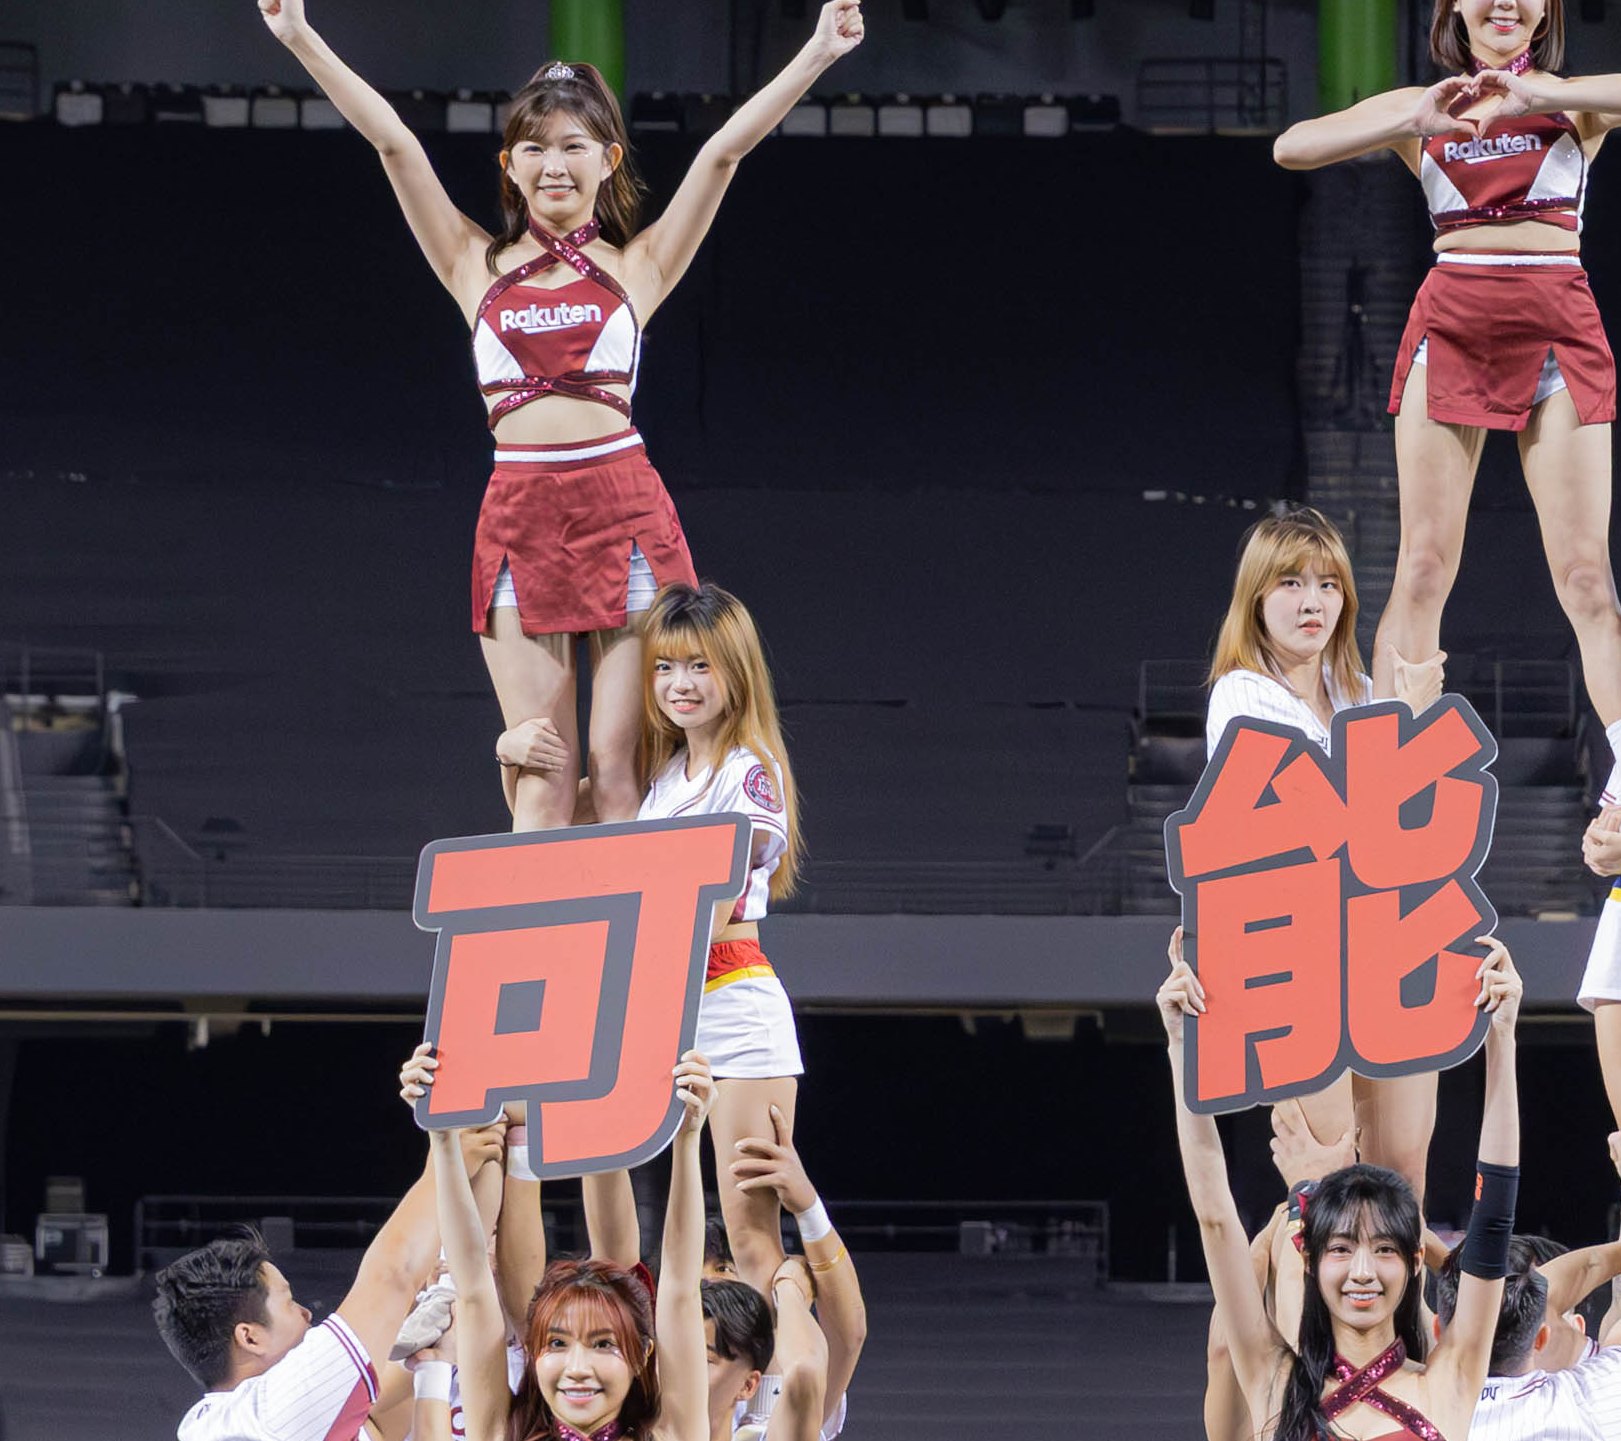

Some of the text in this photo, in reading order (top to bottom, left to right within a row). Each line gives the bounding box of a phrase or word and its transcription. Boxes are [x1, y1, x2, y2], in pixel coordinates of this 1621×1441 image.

[1443, 133, 1542, 164] Rakuten
[499, 302, 602, 335] Rakuten
[426, 822, 737, 1165] 可
[1178, 704, 1492, 1104] 能
